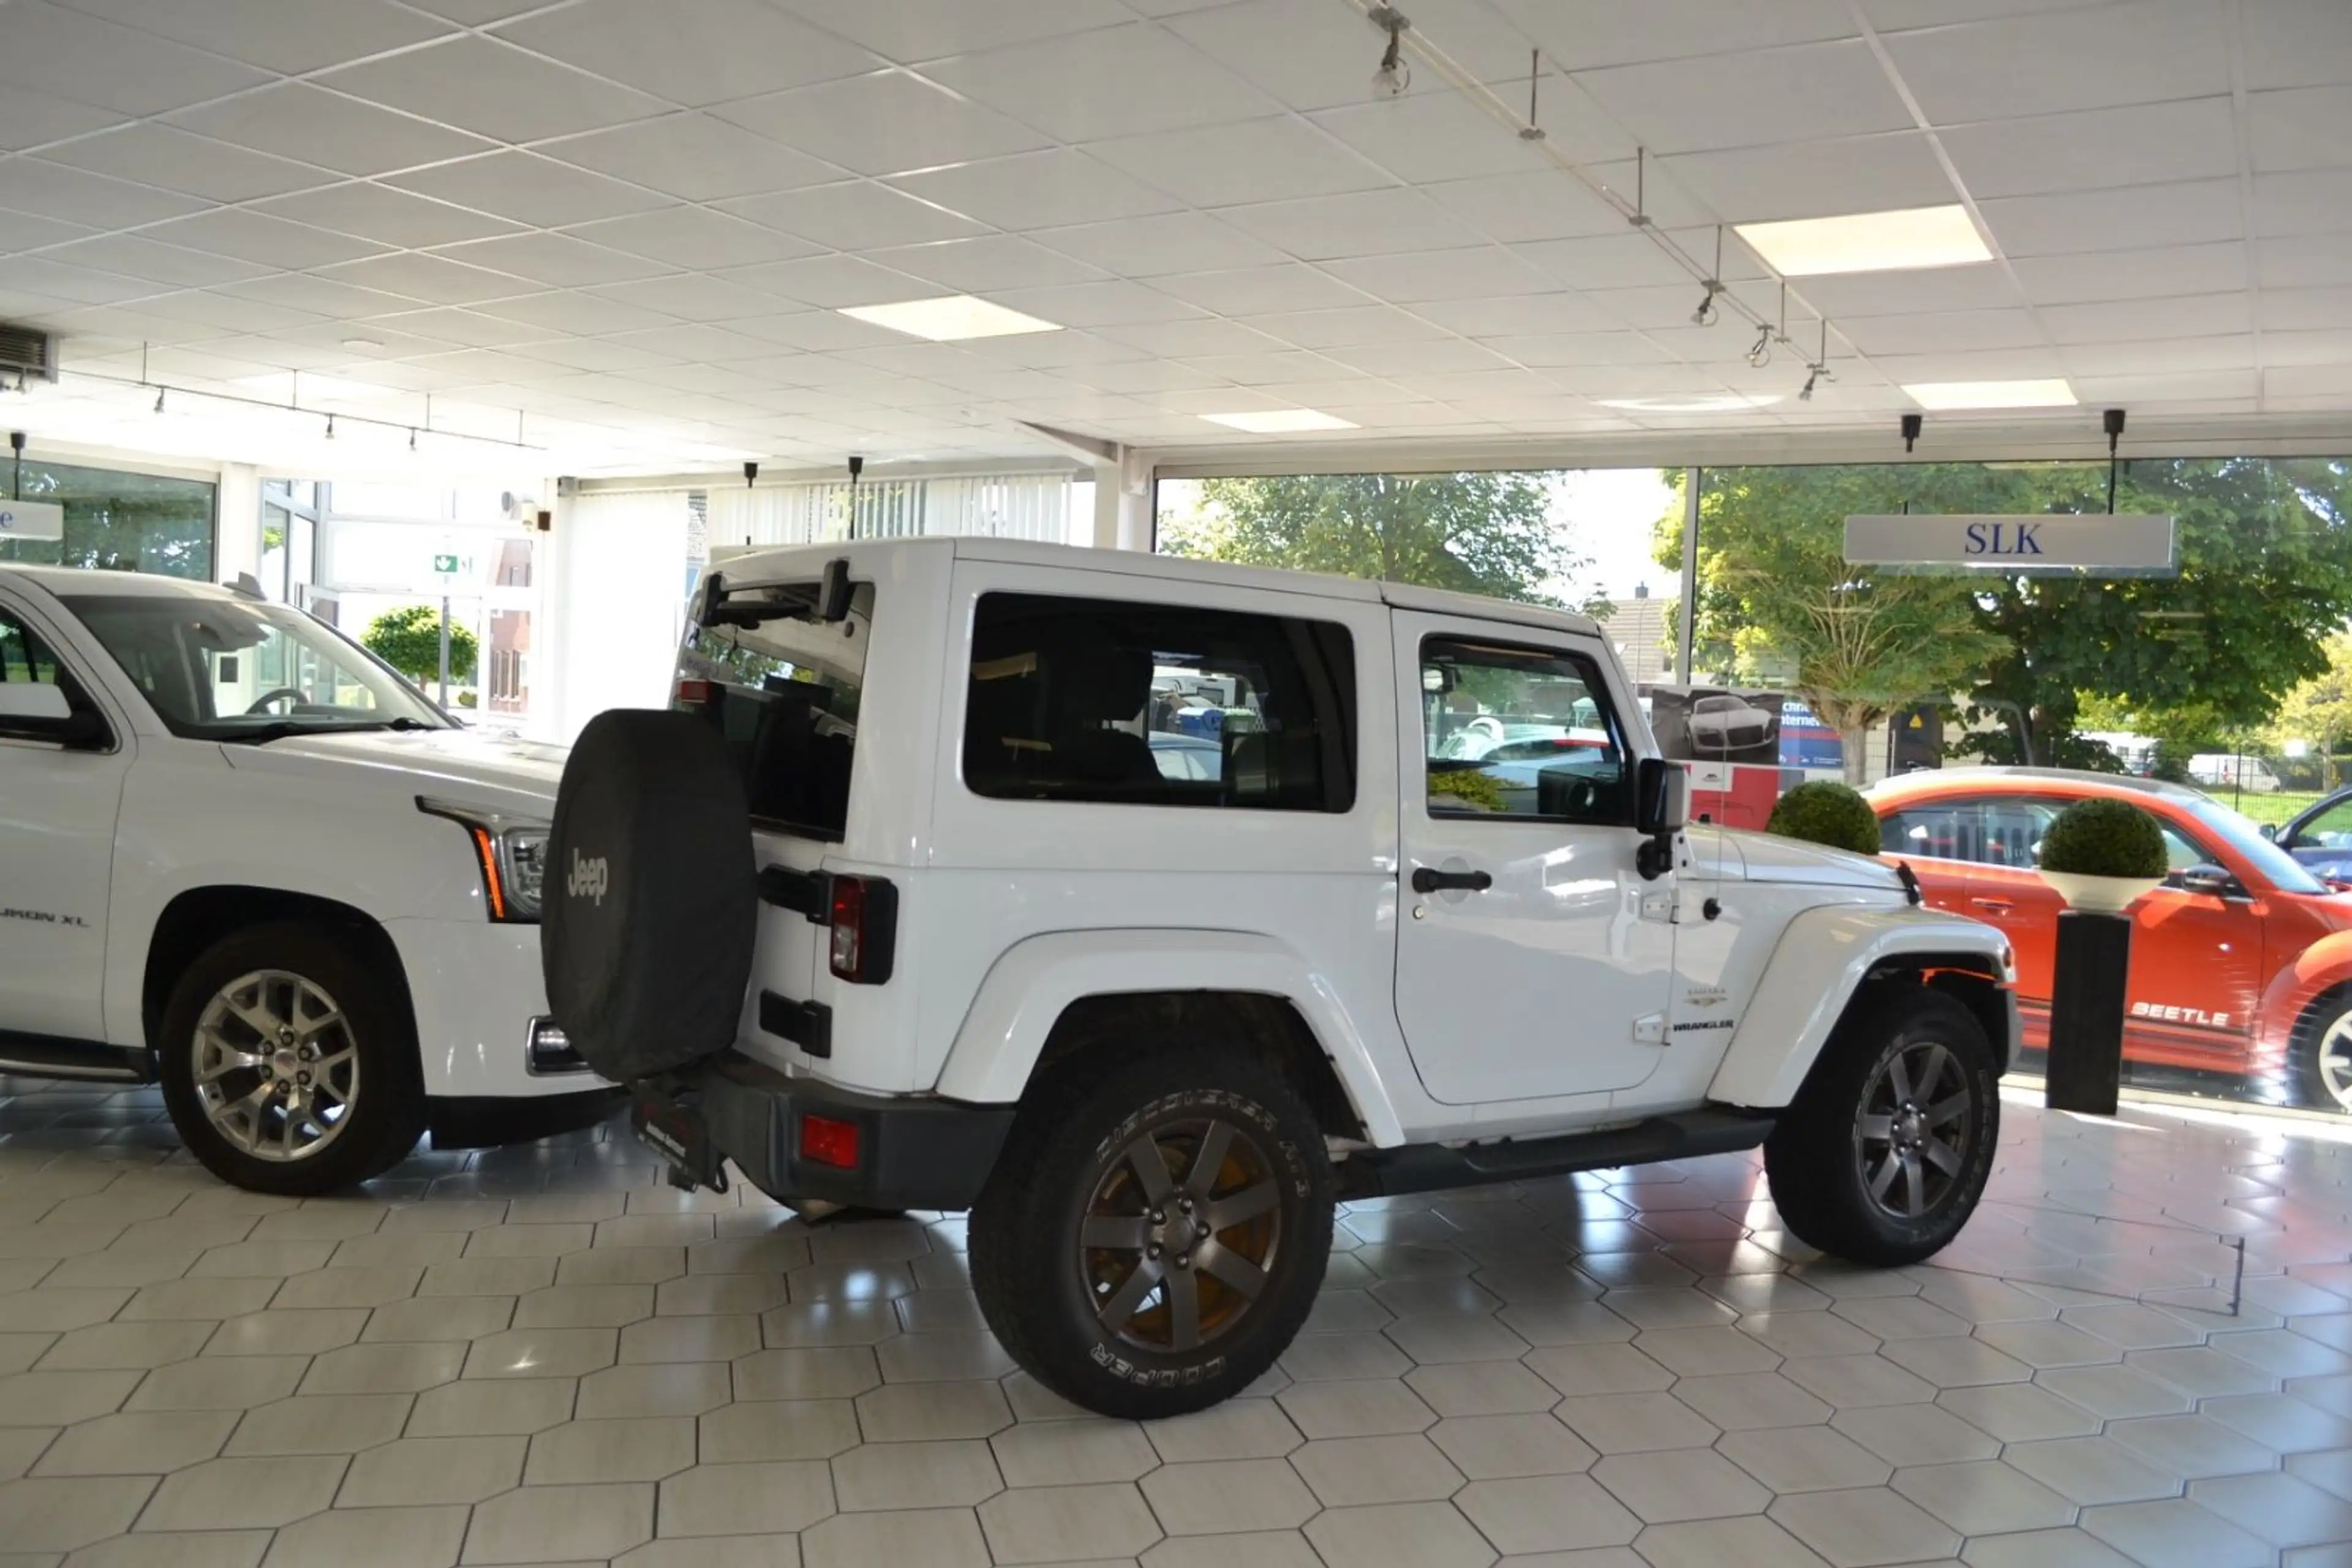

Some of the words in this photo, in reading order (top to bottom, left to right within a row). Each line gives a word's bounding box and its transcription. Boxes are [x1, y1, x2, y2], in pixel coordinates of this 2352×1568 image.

[1965, 522, 2043, 554] SLK
[567, 847, 608, 906] Jeep
[61, 914, 91, 927] XL
[1673, 1019, 1734, 1032] WRANGLER
[2131, 1001, 2230, 1027] BEETLE
[1090, 1342, 1226, 1389] COOPER
